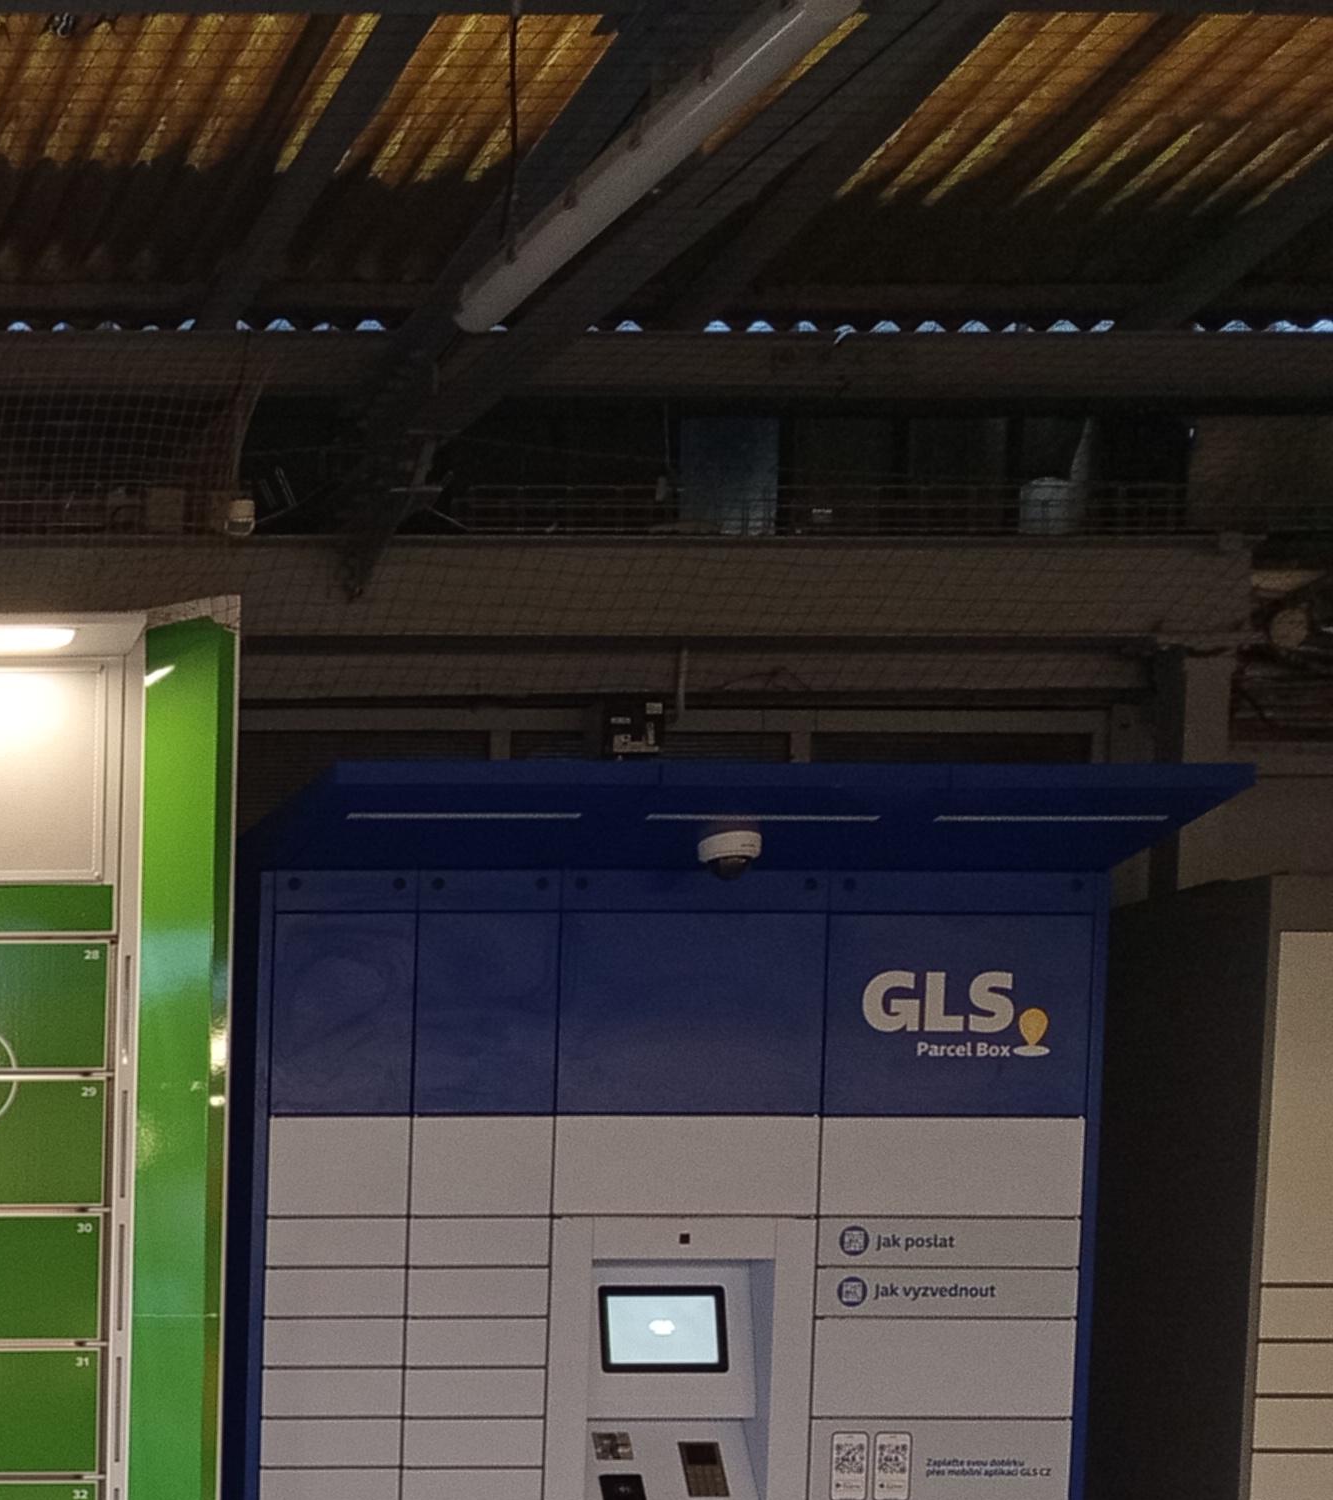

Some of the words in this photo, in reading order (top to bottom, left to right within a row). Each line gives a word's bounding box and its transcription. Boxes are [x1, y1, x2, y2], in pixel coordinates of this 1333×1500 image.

[84, 949, 100, 960] 28
[862, 970, 1016, 1033] GLS
[916, 1041, 973, 1057] Parcel
[976, 1041, 1011, 1057] Box
[81, 1086, 97, 1097] 29
[76, 1222, 93, 1233] 30
[875, 1234, 901, 1251] Jak
[904, 1234, 955, 1251] poslat
[874, 1283, 899, 1300] Jak
[902, 1283, 996, 1301] vyzvednout
[75, 1356, 90, 1367] 31
[73, 1489, 89, 1500] 32
